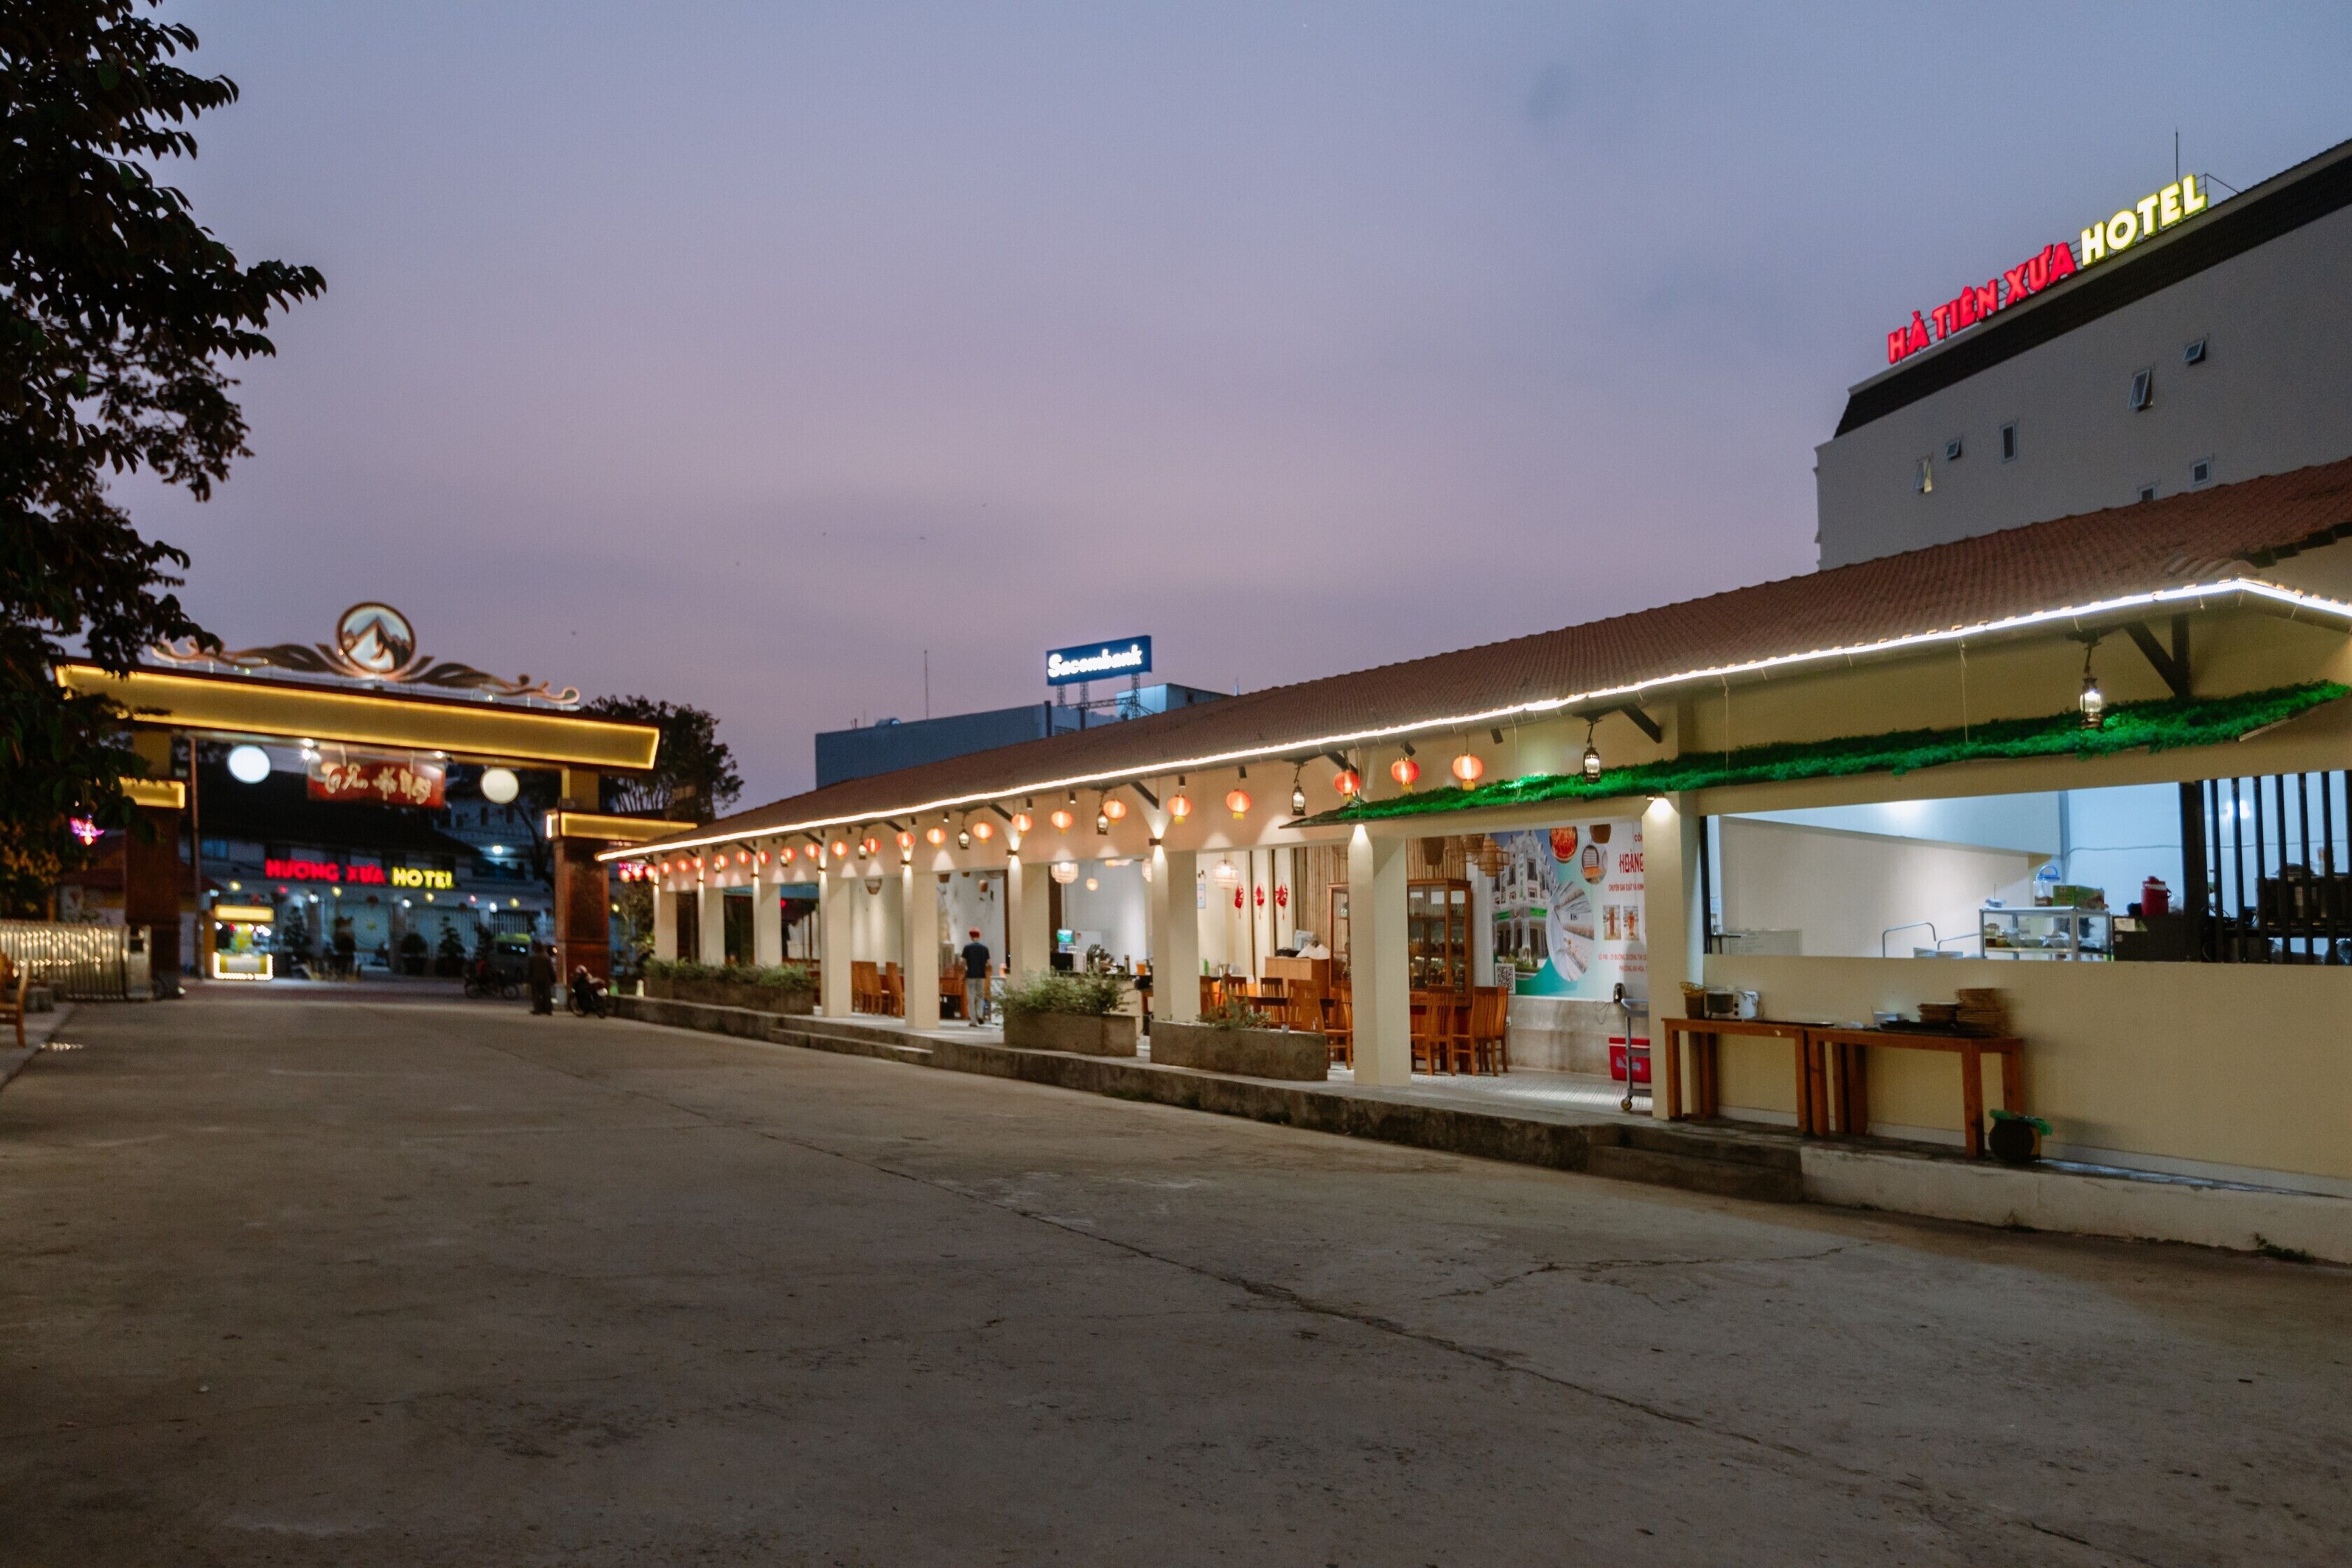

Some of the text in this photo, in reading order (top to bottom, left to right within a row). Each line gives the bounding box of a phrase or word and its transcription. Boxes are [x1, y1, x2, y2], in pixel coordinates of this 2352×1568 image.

[1888, 174, 2207, 364] HÀ TIÊN XƯA HOTEL
[392, 867, 454, 889] HOTEL
